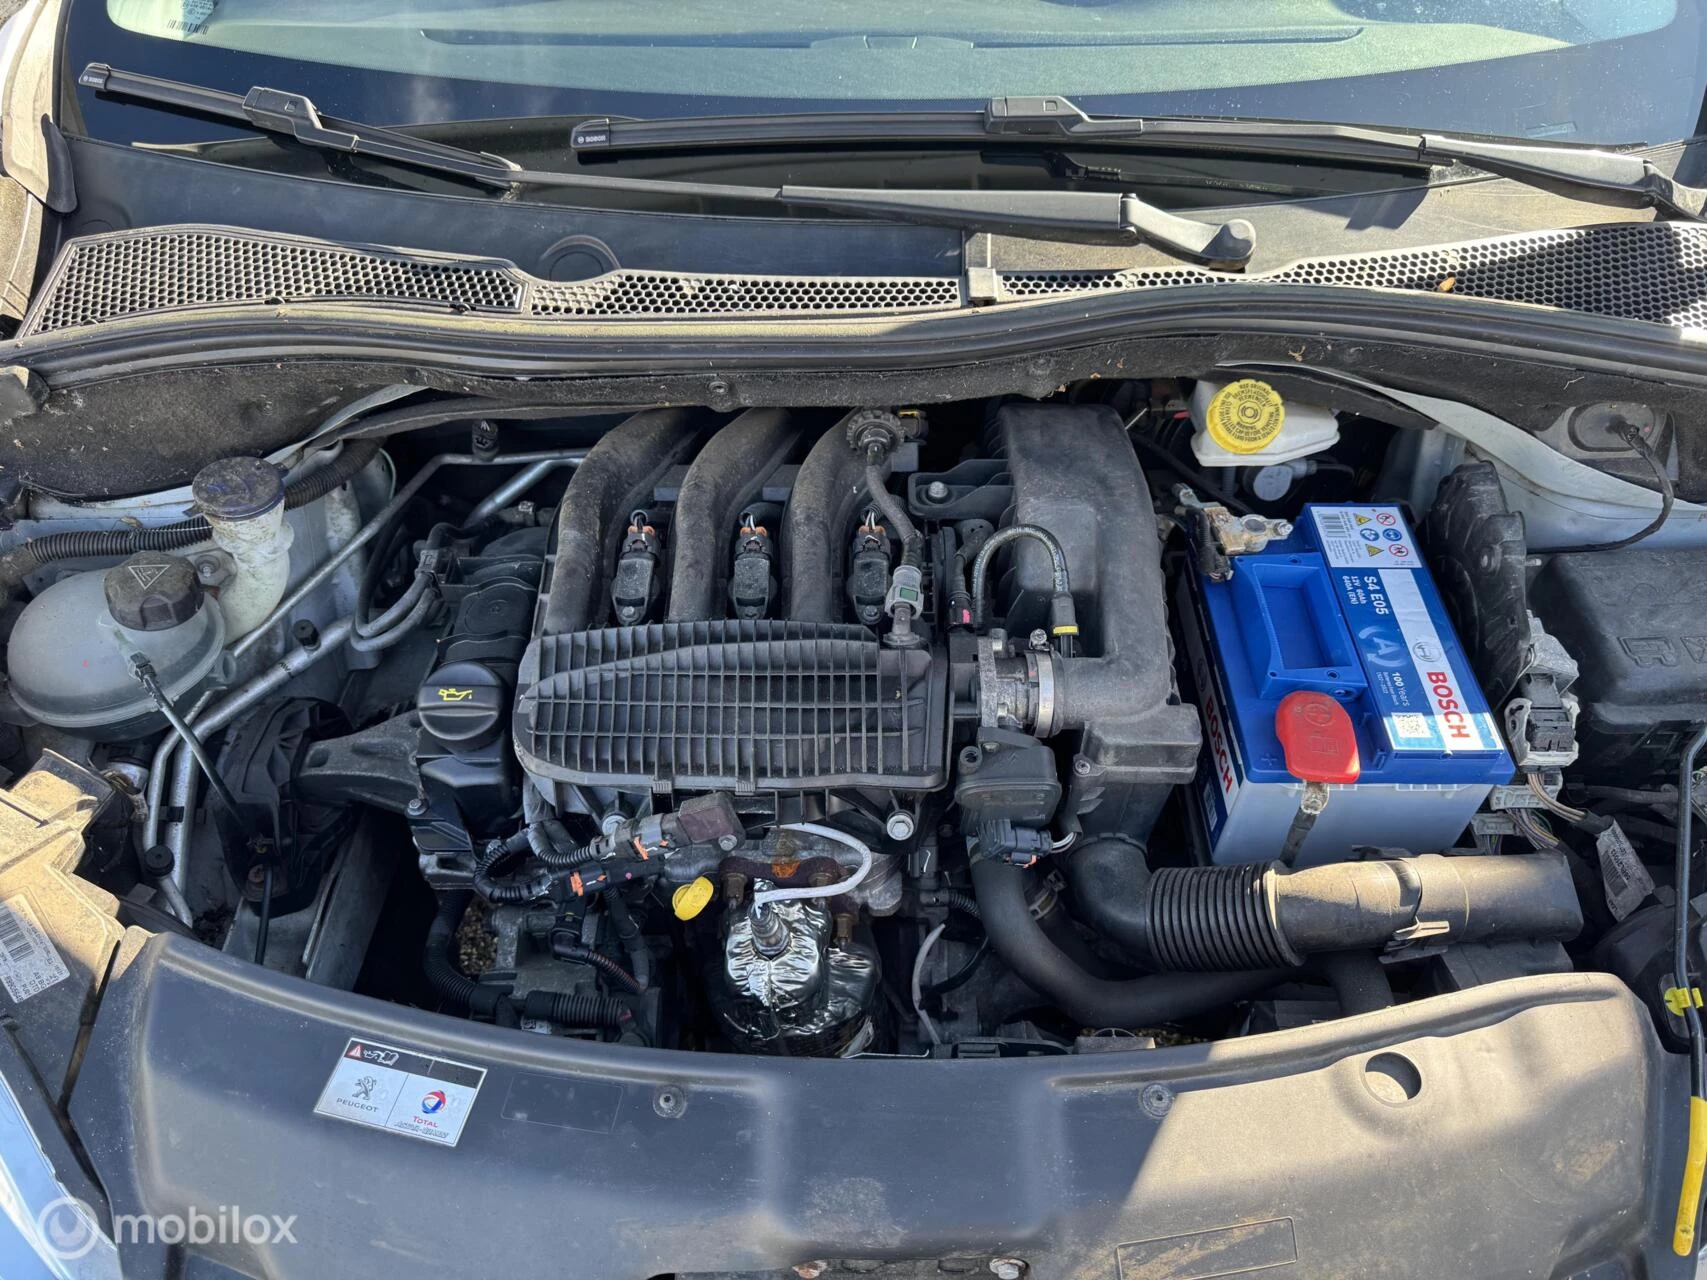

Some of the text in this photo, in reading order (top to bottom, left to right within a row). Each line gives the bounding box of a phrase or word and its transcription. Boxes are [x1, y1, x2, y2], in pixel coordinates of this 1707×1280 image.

[1364, 575, 1389, 615] S4 E05
[1392, 672, 1410, 706] 100 Years
[1426, 672, 1470, 738] BOSCH
[1205, 695, 1233, 794] BOSCH
[336, 1097, 378, 1112] PEUGEOT
[413, 1115, 438, 1128] TOTAL
